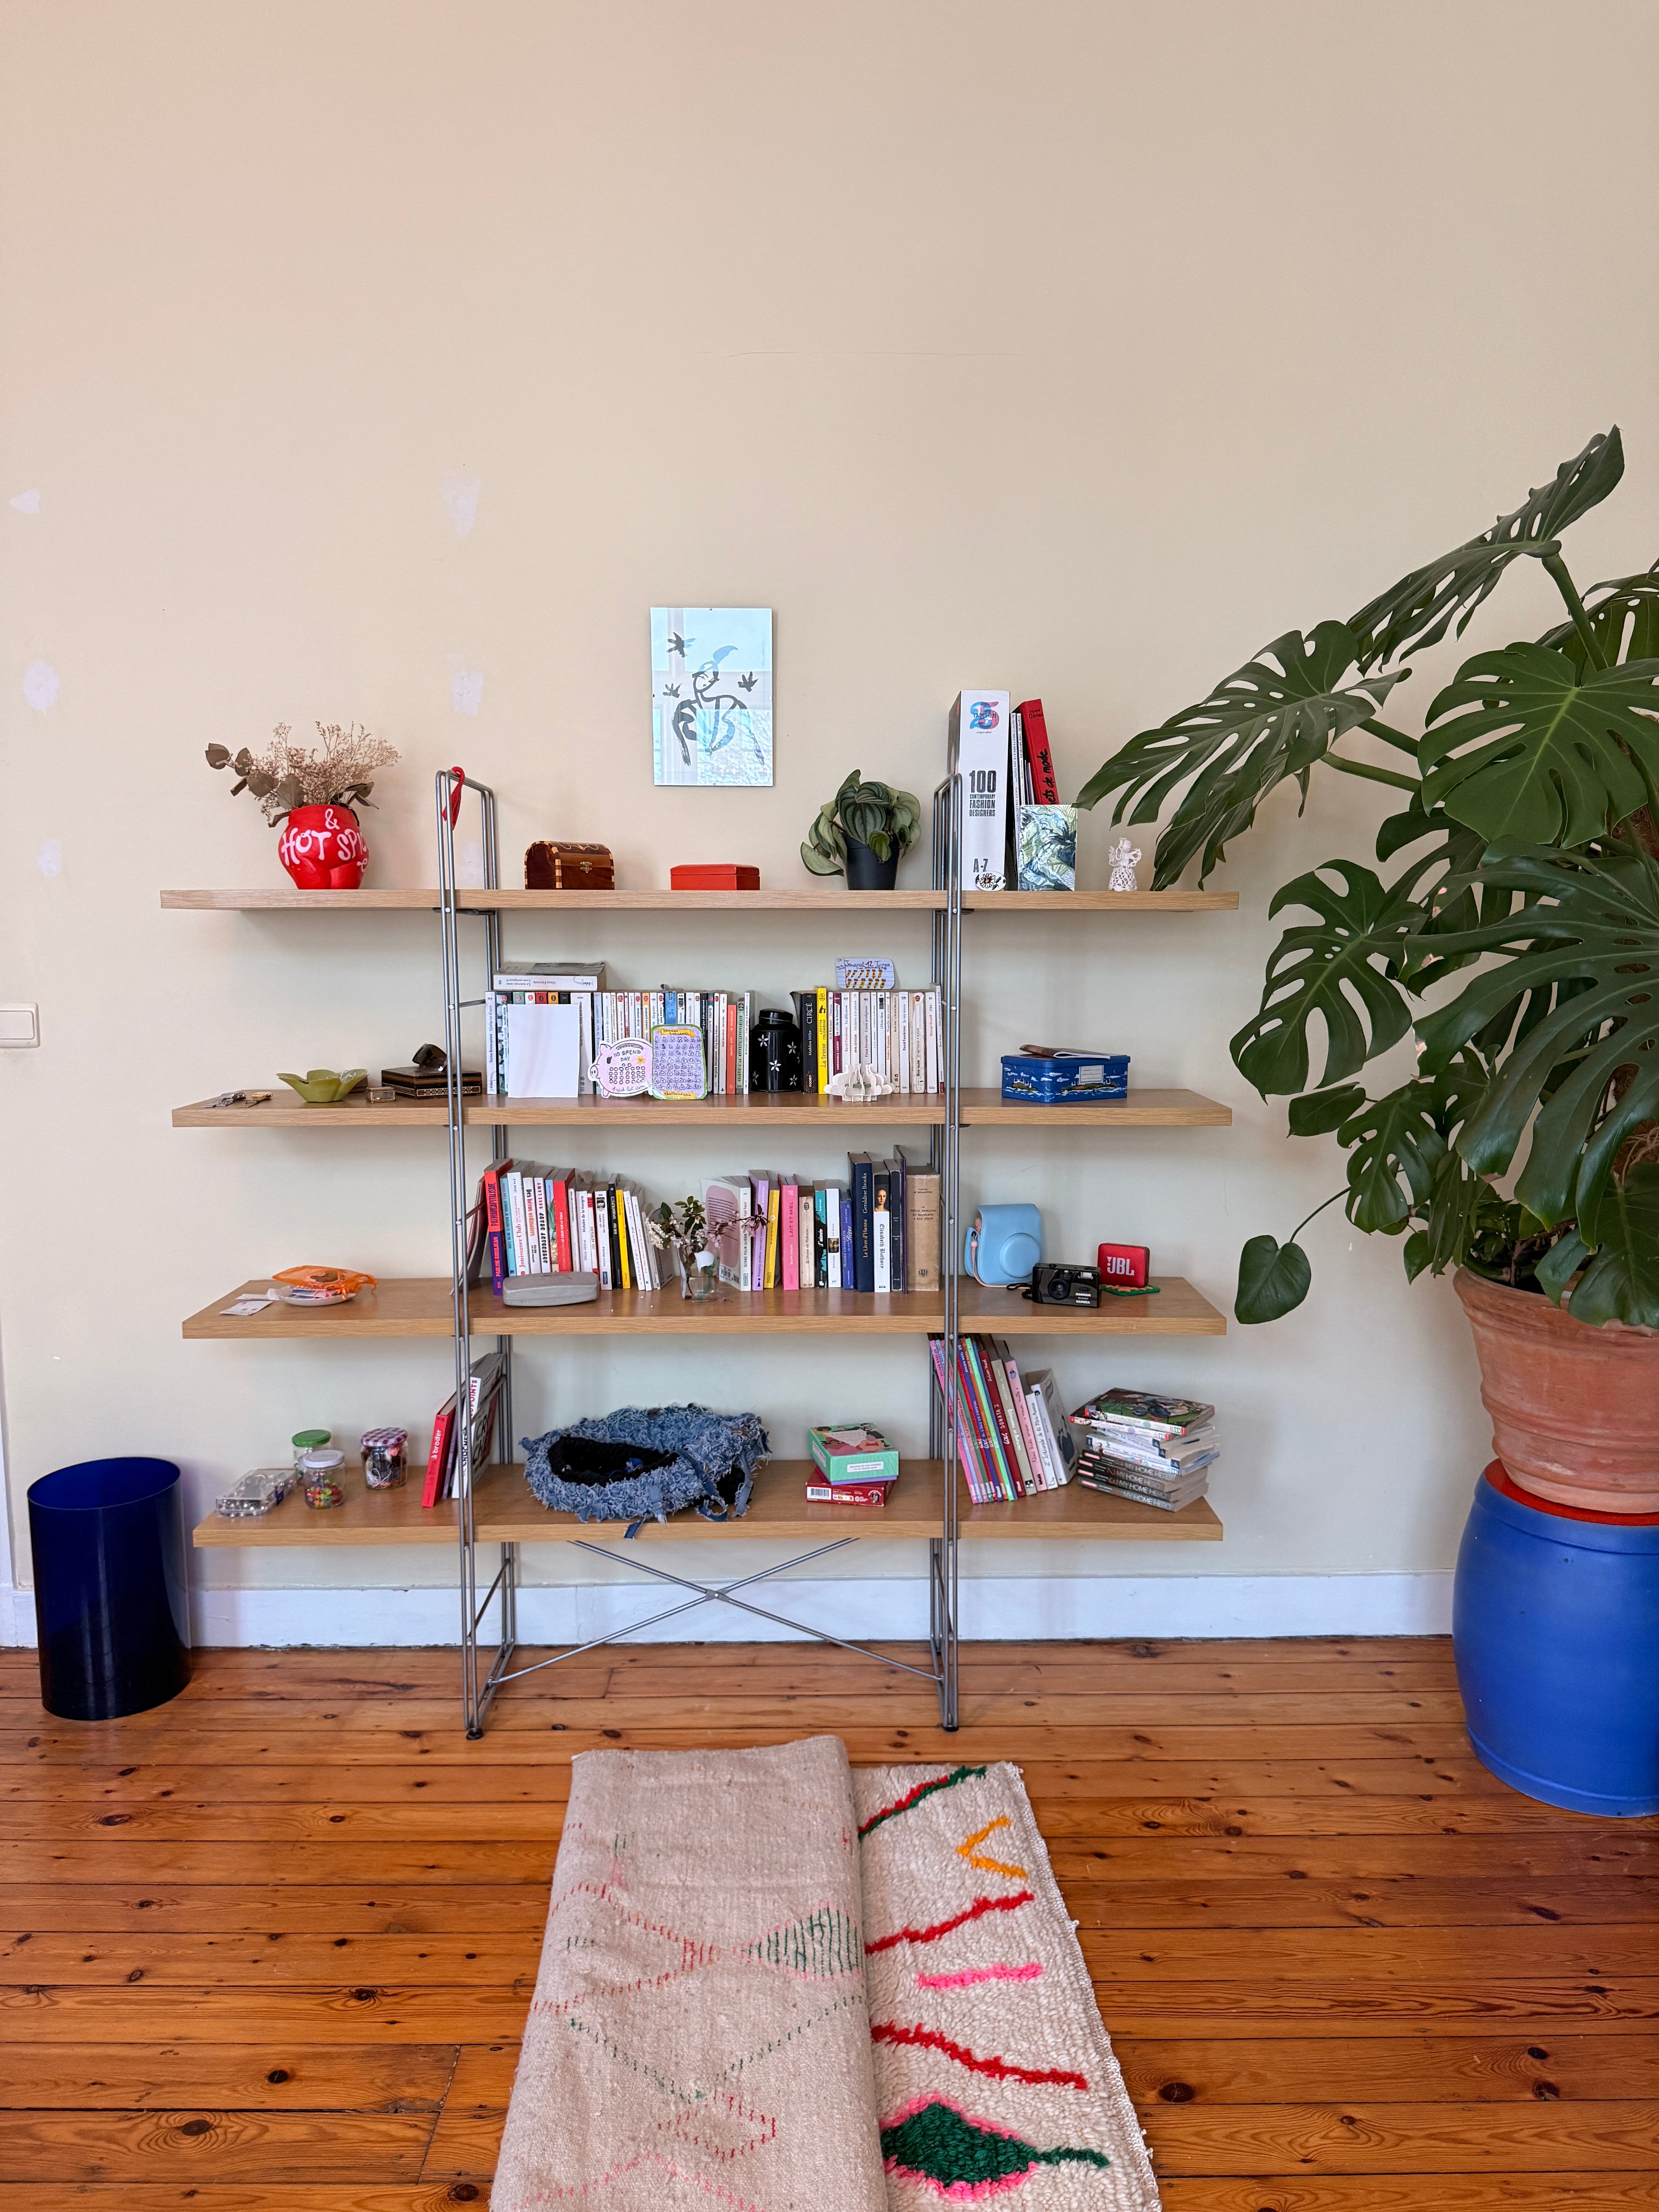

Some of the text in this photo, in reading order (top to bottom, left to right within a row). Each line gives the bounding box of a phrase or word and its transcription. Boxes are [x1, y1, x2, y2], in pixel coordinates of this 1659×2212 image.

[1036, 748, 1051, 773] mode
[969, 770, 996, 793] 100
[970, 800, 995, 809] FASHION
[281, 827, 332, 866] HOT
[325, 809, 340, 830] &
[488, 1182, 499, 1226] PATRIARCAPITALISME
[1107, 1256, 1135, 1276] JBL
[997, 1409, 1005, 1429] SONATA
[432, 1429, 442, 1453] broder
[1135, 1465, 1154, 1475] HOME
[1126, 1473, 1143, 1483] HOME
[1144, 1478, 1160, 1488] HERO
[1129, 1481, 1148, 1492] HOME
[1149, 1487, 1166, 1497] HERO
[1133, 1494, 1153, 1504] HOME
[1154, 1498, 1171, 1510] HERO
